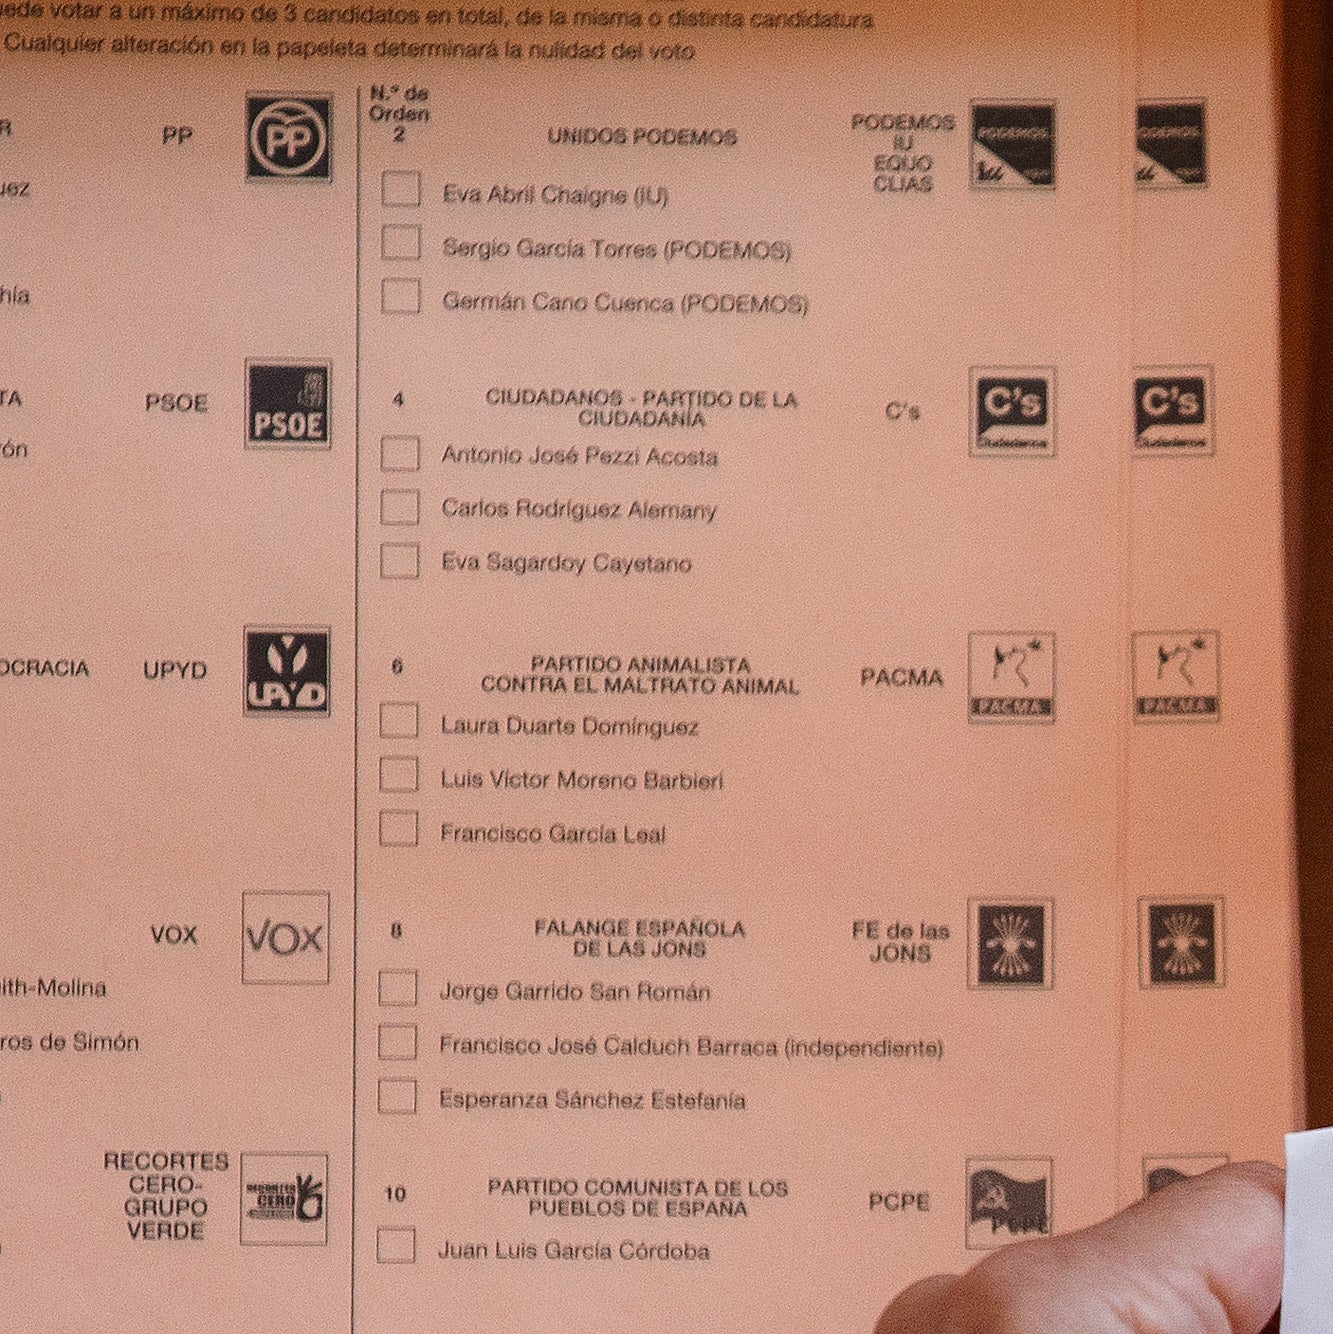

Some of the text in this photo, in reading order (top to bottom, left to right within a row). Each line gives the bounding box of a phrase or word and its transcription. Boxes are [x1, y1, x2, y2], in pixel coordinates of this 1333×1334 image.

[850, 113, 957, 133] PODEMOS
[161, 124, 195, 146] PP
[266, 123, 312, 158] PP
[546, 126, 739, 147] UNIDOS PODEMOS
[633, 185, 670, 208] (IU)
[144, 392, 208, 414] PSOE
[254, 411, 323, 438] PSOE
[142, 659, 209, 682] UPYD
[530, 654, 752, 676] PARTIDO ANIMALISTA
[480, 674, 799, 696] CONTRA EL MALTRATO ANIMAL
[859, 666, 945, 688] PACMA
[248, 681, 326, 708] UPYD
[149, 924, 199, 946] VOX
[247, 919, 324, 954] VOX
[533, 917, 747, 940] FALANGE ESPAÑOLA
[103, 1150, 231, 1173] RECORTES
[127, 1174, 203, 1196] CERO-
[123, 1196, 210, 1220] GRUPO
[868, 1190, 930, 1213] PCPE
[126, 1220, 204, 1242] VERDE
